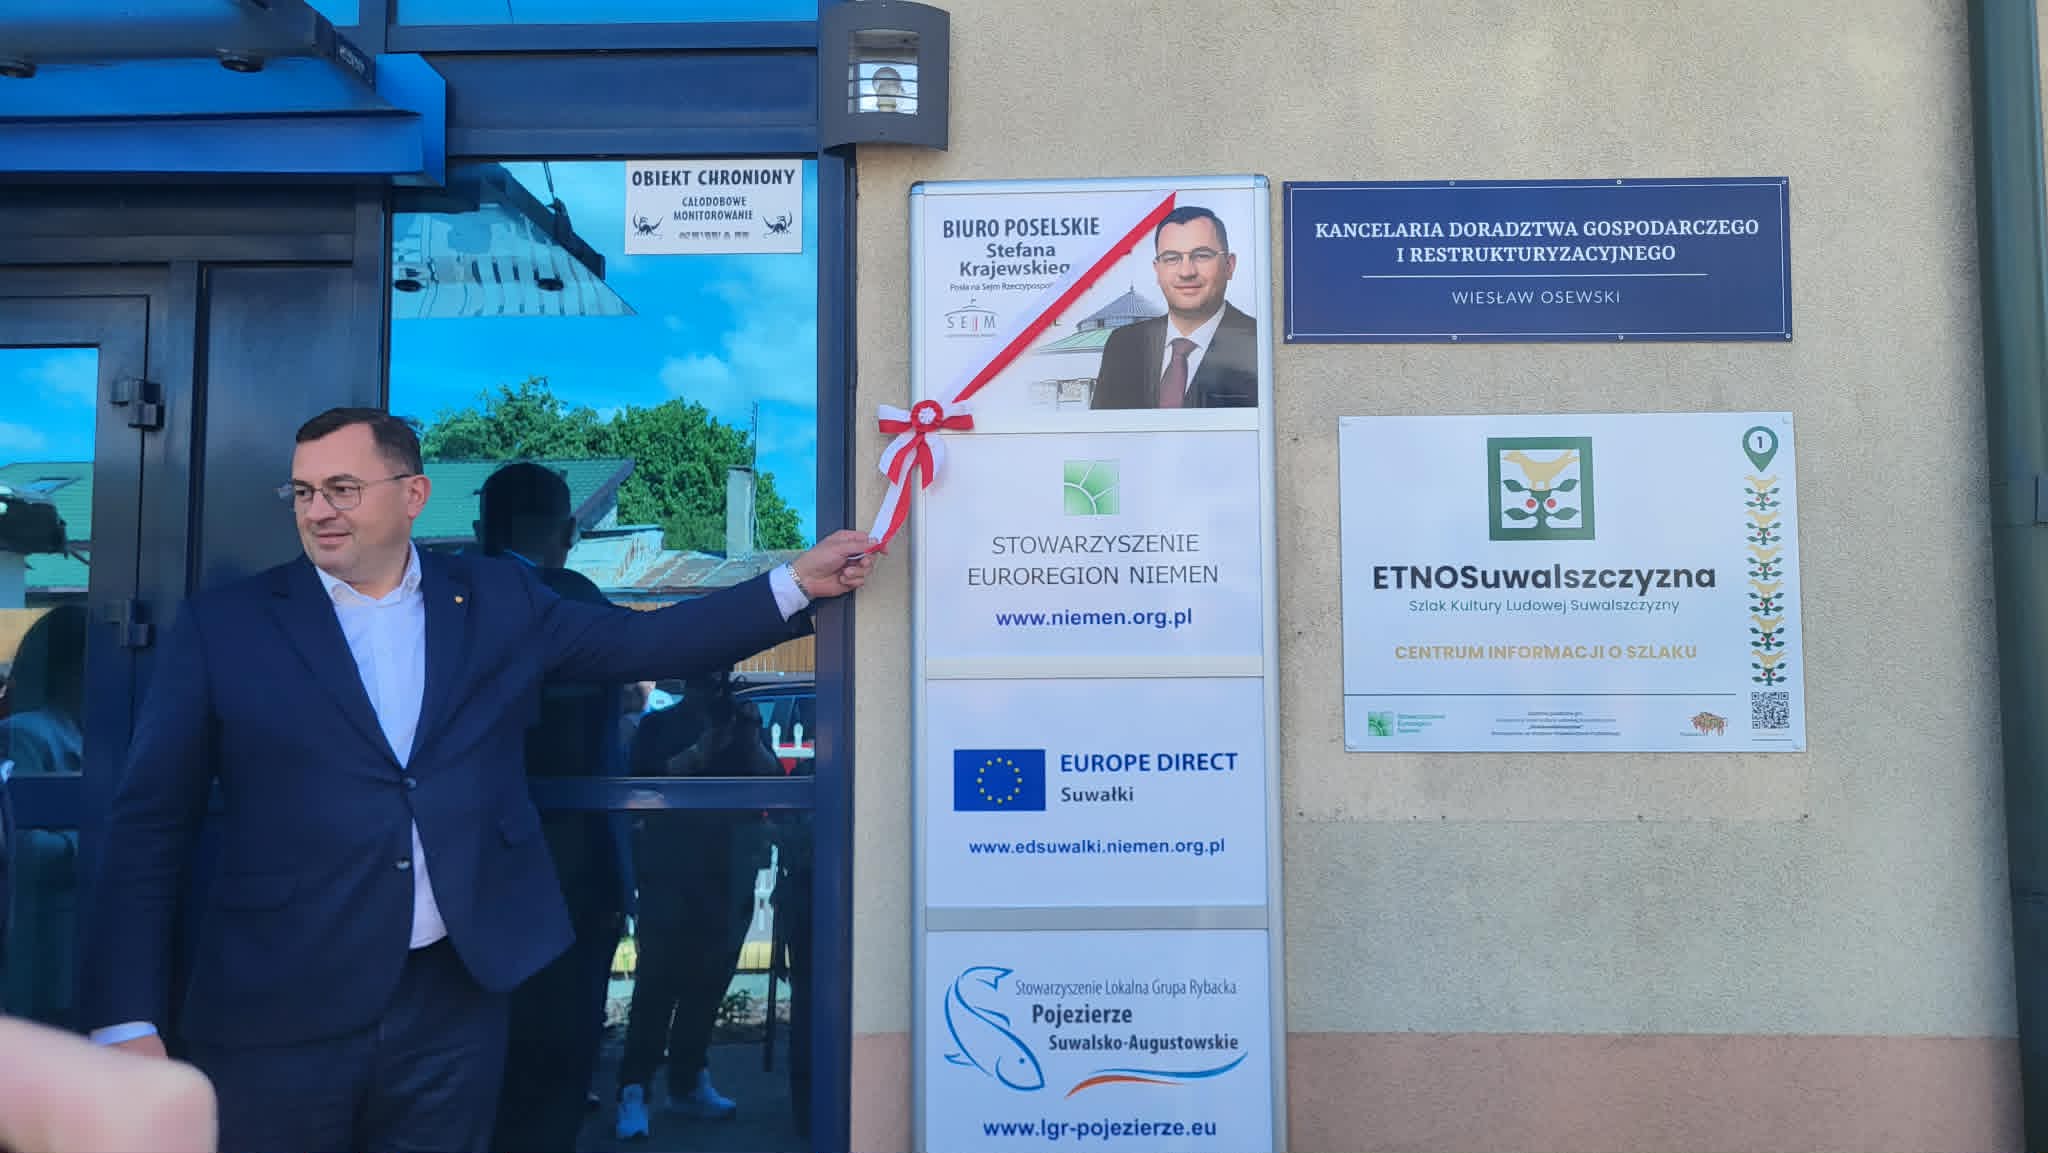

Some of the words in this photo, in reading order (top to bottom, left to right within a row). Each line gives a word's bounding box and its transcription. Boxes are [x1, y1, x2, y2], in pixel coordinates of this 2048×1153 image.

[632, 170, 690, 186] OBIEKT
[697, 169, 796, 185] CHRONIONY
[682, 196, 747, 207] CAŁODOBOWE
[673, 210, 752, 221] MONITOROWANIE
[943, 220, 1000, 238] BIURO
[1004, 217, 1100, 236] POSELSKIE
[1315, 221, 1444, 239] KANCELARIA
[1449, 221, 1578, 238] DORADZTWA
[1583, 219, 1760, 237] GOSPODARCZEGO
[987, 242, 1056, 257] Stefana
[1397, 248, 1404, 262] I
[1410, 245, 1676, 264] RESTRUKTURYZACYJNEGO
[1452, 290, 1534, 305] WIESŁAW
[1541, 290, 1621, 304] OSEWSKI
[1757, 436, 1763, 448] 1
[992, 534, 1200, 554] STOWARZYSZENIE
[968, 567, 1119, 586] EUROREGION
[1130, 565, 1218, 584] NIEMEN
[1373, 564, 1716, 596] ETNOSuwalszczyzna
[1409, 600, 1447, 612] Szlak
[1451, 599, 1502, 614] Kultury
[1506, 599, 1567, 614] Ludowej
[1571, 599, 1680, 614] Suwalszczyzny
[996, 608, 1192, 629] www.niemen.org.pl
[1395, 646, 1484, 660] CENTRUM
[1488, 645, 1604, 659] INFORMACJI
[1609, 645, 1622, 659] O
[1627, 644, 1697, 659] SZLAKU
[1061, 754, 1151, 772] EUROPE
[1158, 753, 1238, 771] DIRECT
[1061, 786, 1134, 802] Suwałki
[969, 838, 1226, 856] www.edsuwalki.niemen.org.pl
[1015, 979, 1101, 997] Stowarzyszenie
[1106, 979, 1149, 995] Lokalna
[1152, 979, 1186, 997] Grupa
[1190, 978, 1237, 996] Rybacka
[1032, 1004, 1133, 1029] Pojezierze
[1049, 1033, 1239, 1053] Suwalsko-Augustowskie
[984, 1117, 1217, 1140] www.lgr-pojezierze.eu
